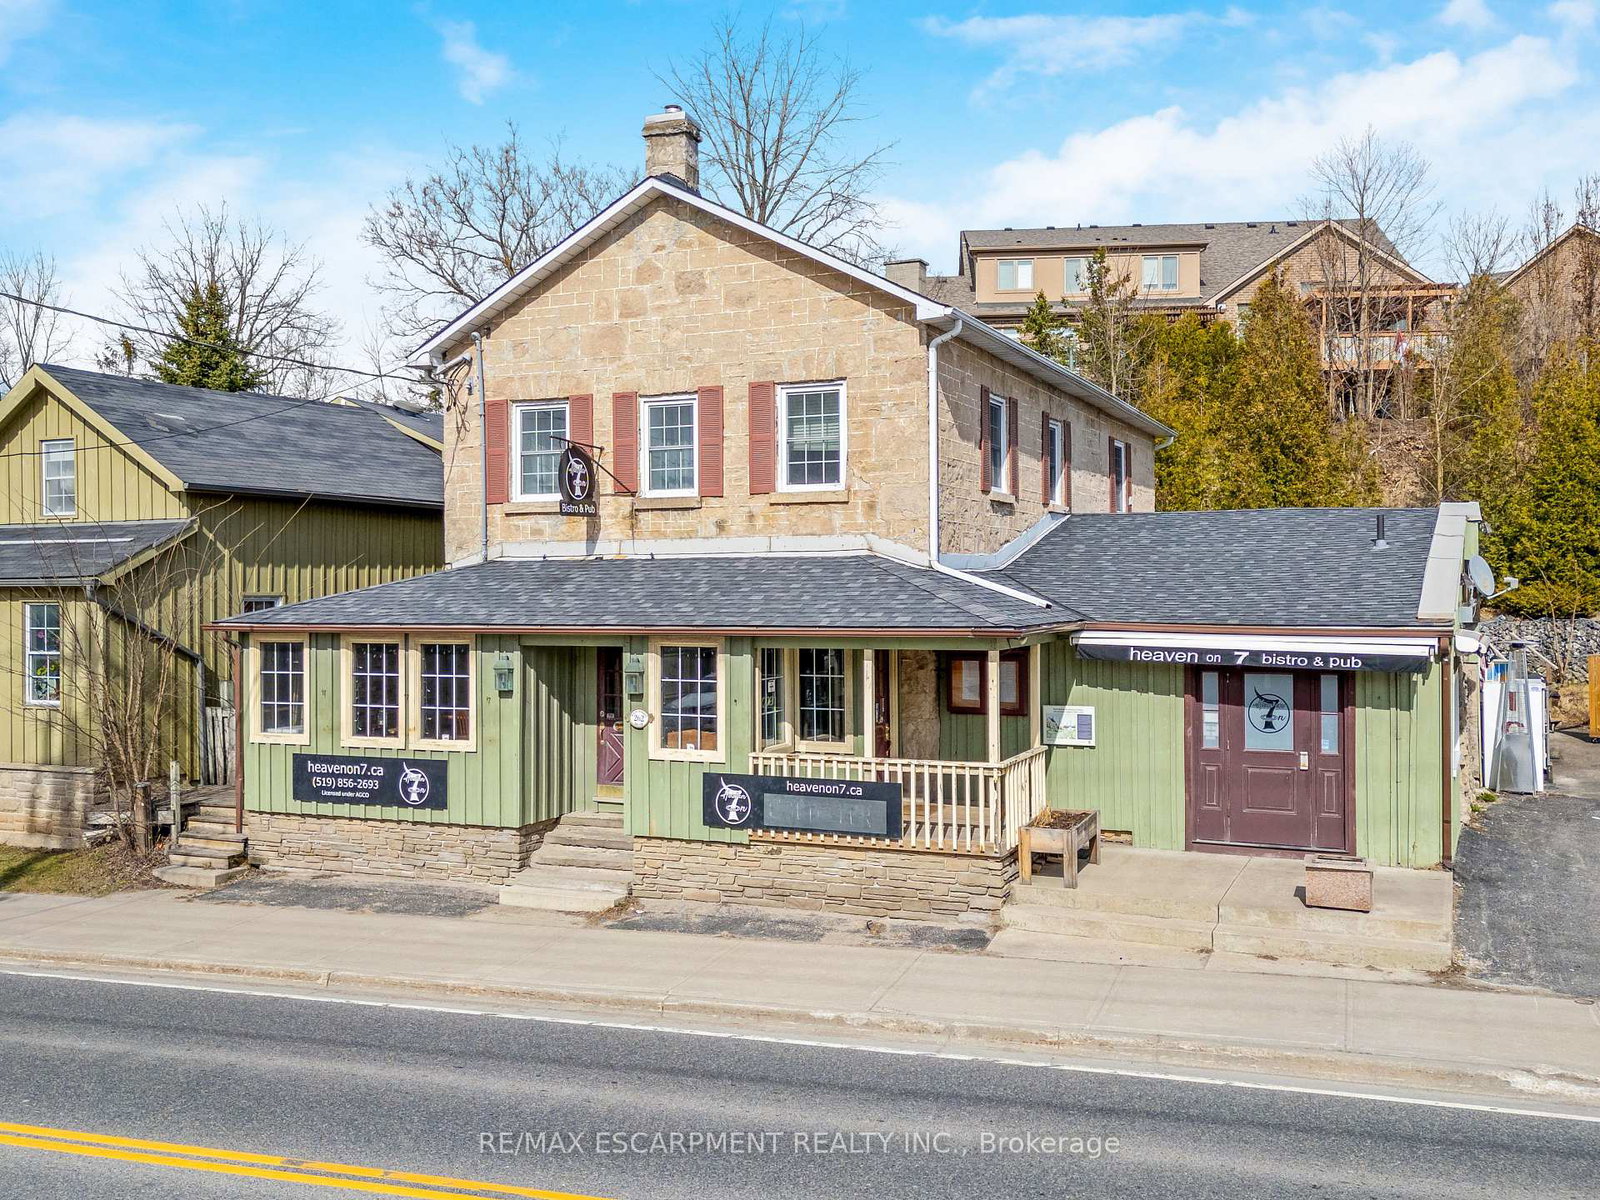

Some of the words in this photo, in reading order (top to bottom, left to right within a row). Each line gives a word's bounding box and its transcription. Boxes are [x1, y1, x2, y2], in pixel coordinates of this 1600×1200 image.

[561, 503, 579, 513] Bistro
[579, 503, 584, 513] &
[585, 503, 596, 514] Pub
[1129, 646, 1199, 663] heaven
[1206, 654, 1221, 663] on
[1233, 651, 1250, 665] 7
[1262, 653, 1308, 666] bistro
[1313, 656, 1324, 667] &
[1329, 656, 1362, 668] pub
[307, 760, 384, 776] heavenon7.ca
[312, 776, 336, 789] (519)
[337, 778, 379, 790] 856-2693
[786, 780, 863, 796] heavenon7.ca
